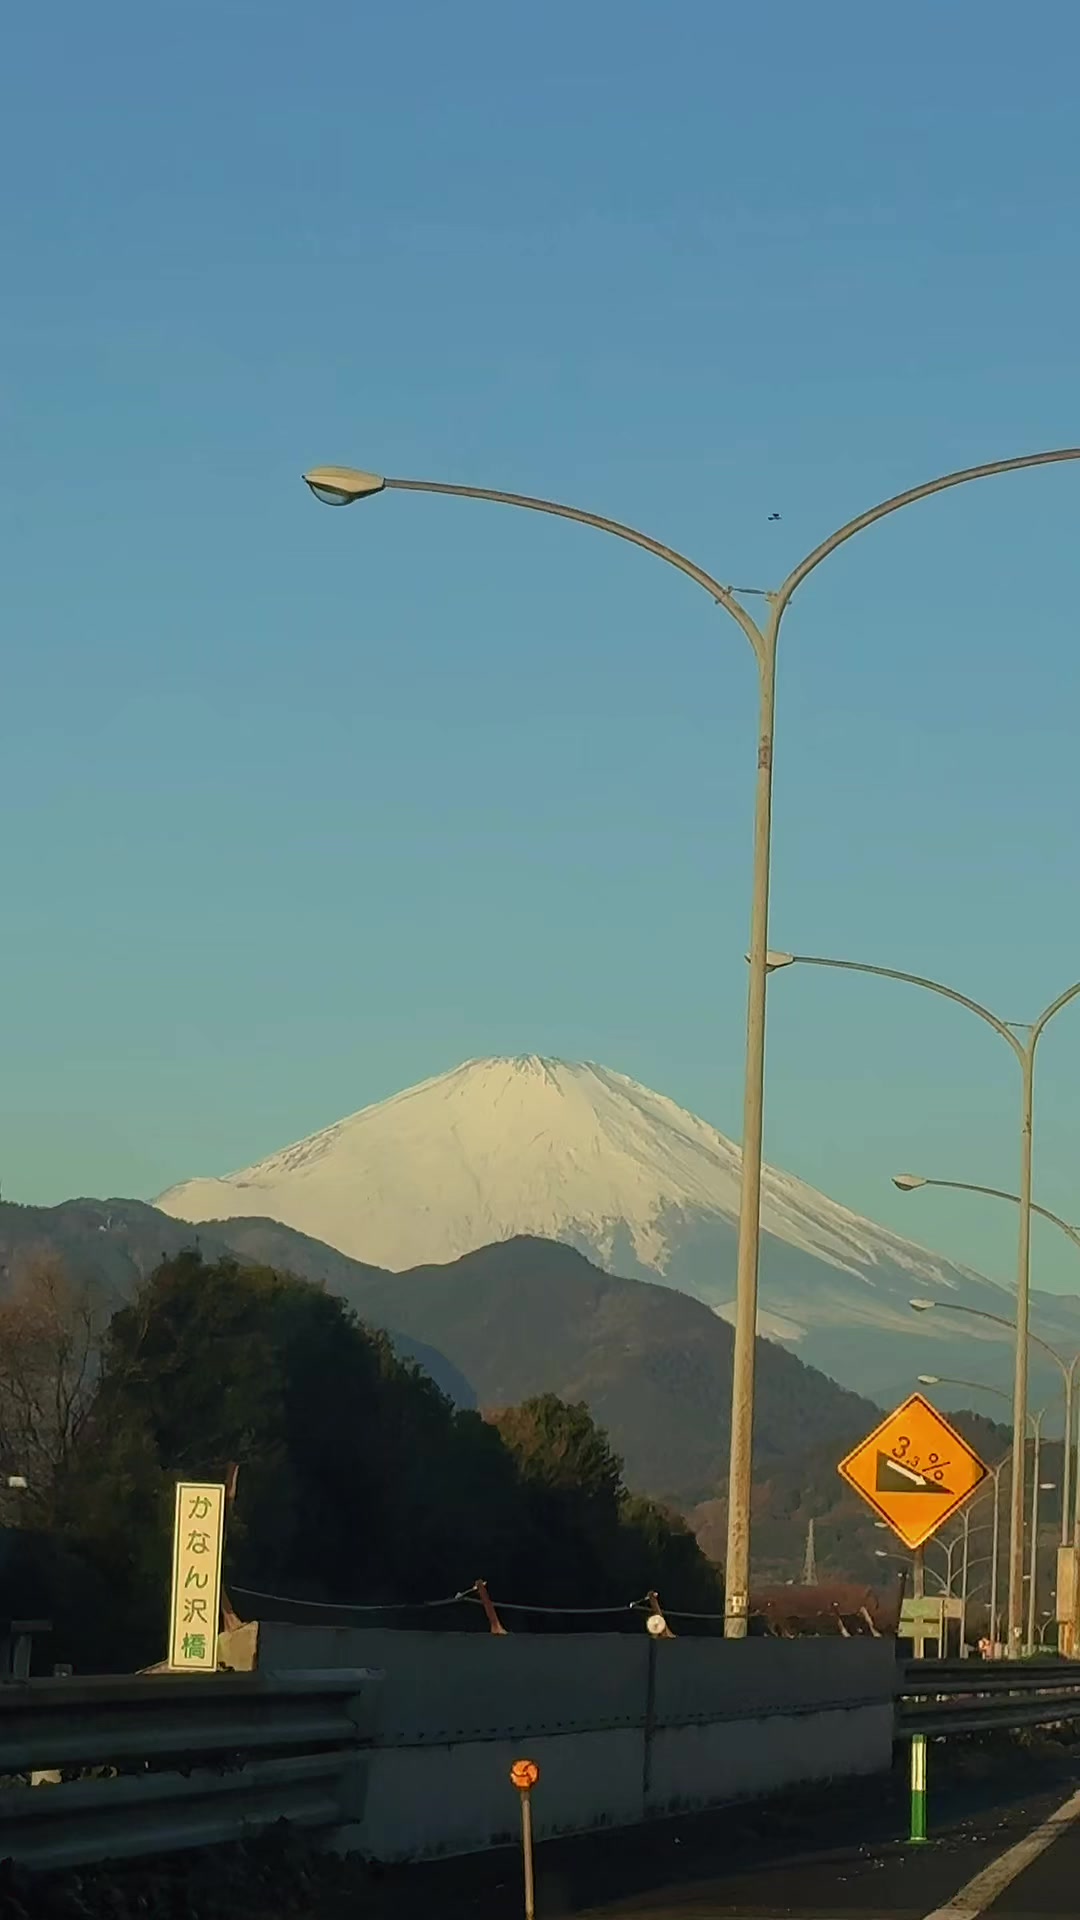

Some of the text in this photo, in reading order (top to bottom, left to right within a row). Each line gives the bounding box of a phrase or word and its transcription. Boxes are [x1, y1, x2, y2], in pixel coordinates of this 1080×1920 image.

[892, 1436, 951, 1480] 3.3%
[181, 1495, 212, 1660] かなん沢橋
